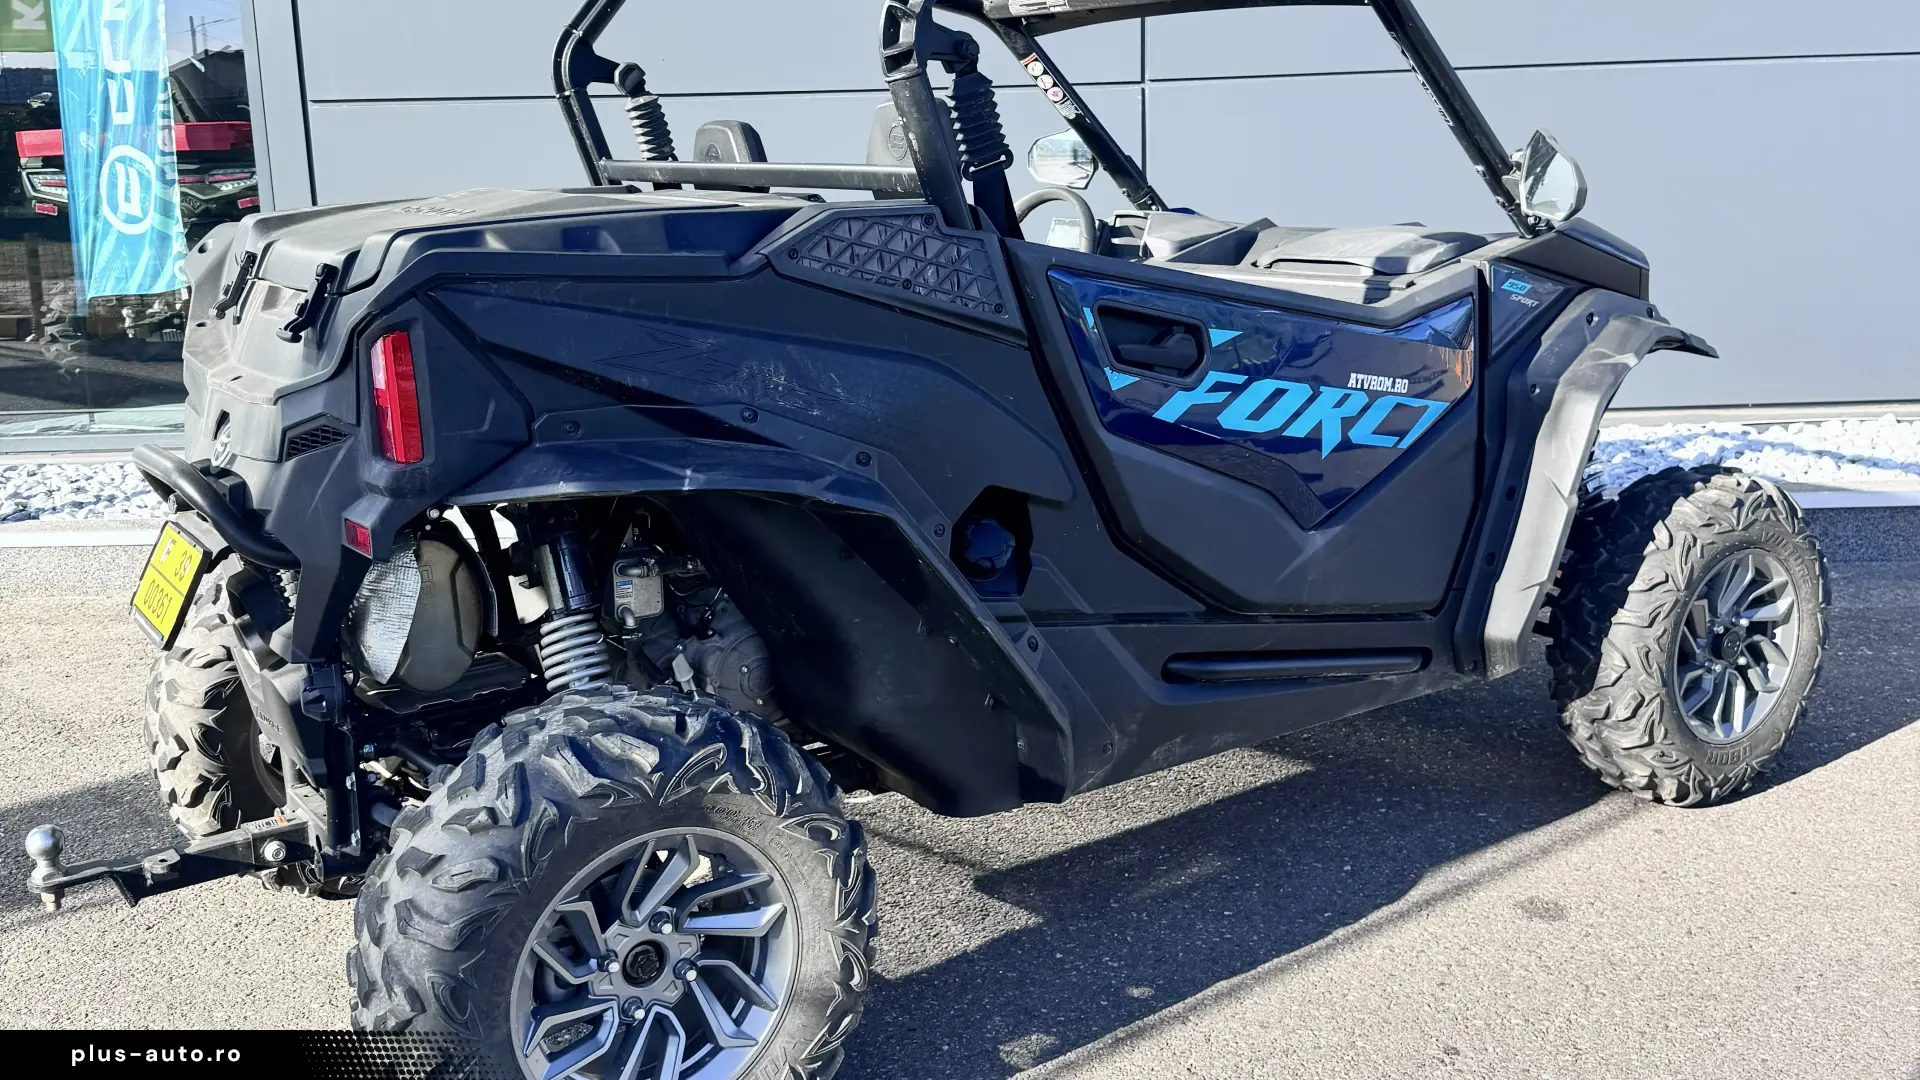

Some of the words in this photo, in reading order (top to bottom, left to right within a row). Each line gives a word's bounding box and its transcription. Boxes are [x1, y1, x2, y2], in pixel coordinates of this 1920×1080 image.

[1507, 281, 1527, 291] 950
[1510, 293, 1539, 307] SPORT
[1347, 372, 1409, 394] ATVROM.RO
[144, 579, 172, 624] 00361
